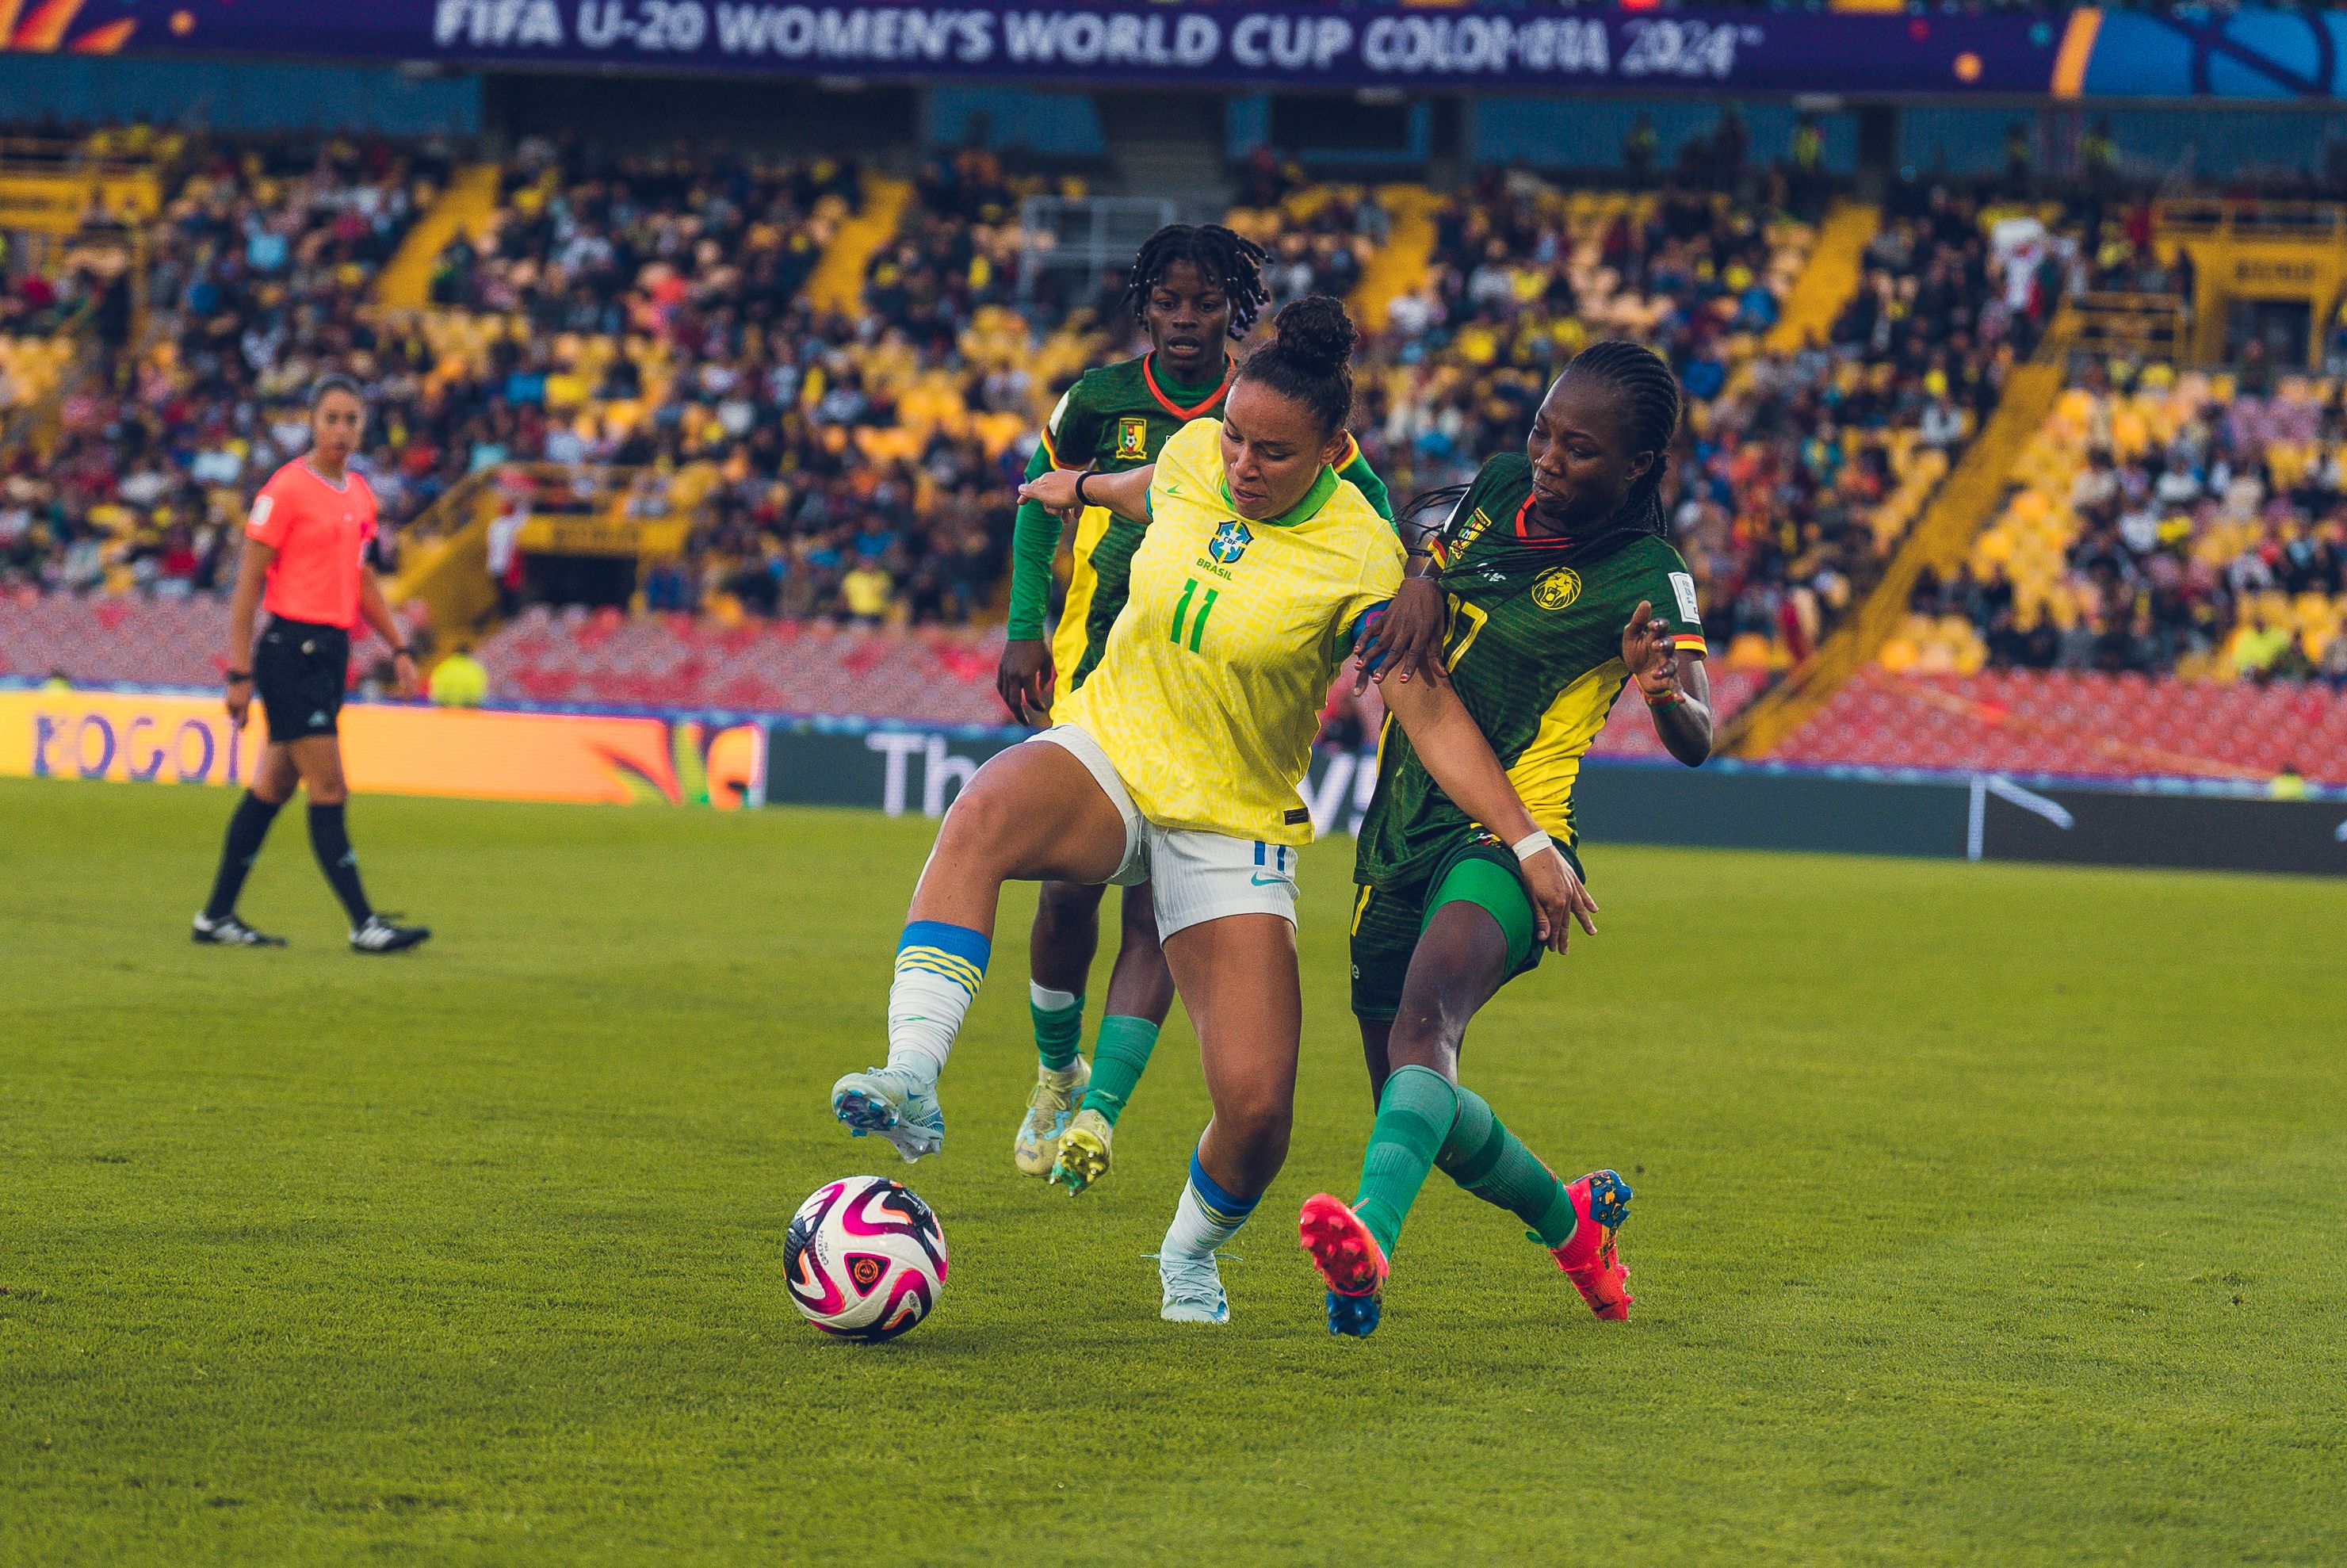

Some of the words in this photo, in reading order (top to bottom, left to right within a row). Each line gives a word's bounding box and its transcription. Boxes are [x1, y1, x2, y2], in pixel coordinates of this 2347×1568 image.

[433, 0, 564, 47] FIFA
[575, 0, 708, 51] U-20
[713, 4, 996, 62] WOMEN'S
[1002, 10, 1221, 67] WORLD
[1230, 13, 1355, 69] CUP
[1196, 557, 1233, 581] BRASIL
[1170, 577, 1219, 655] 11
